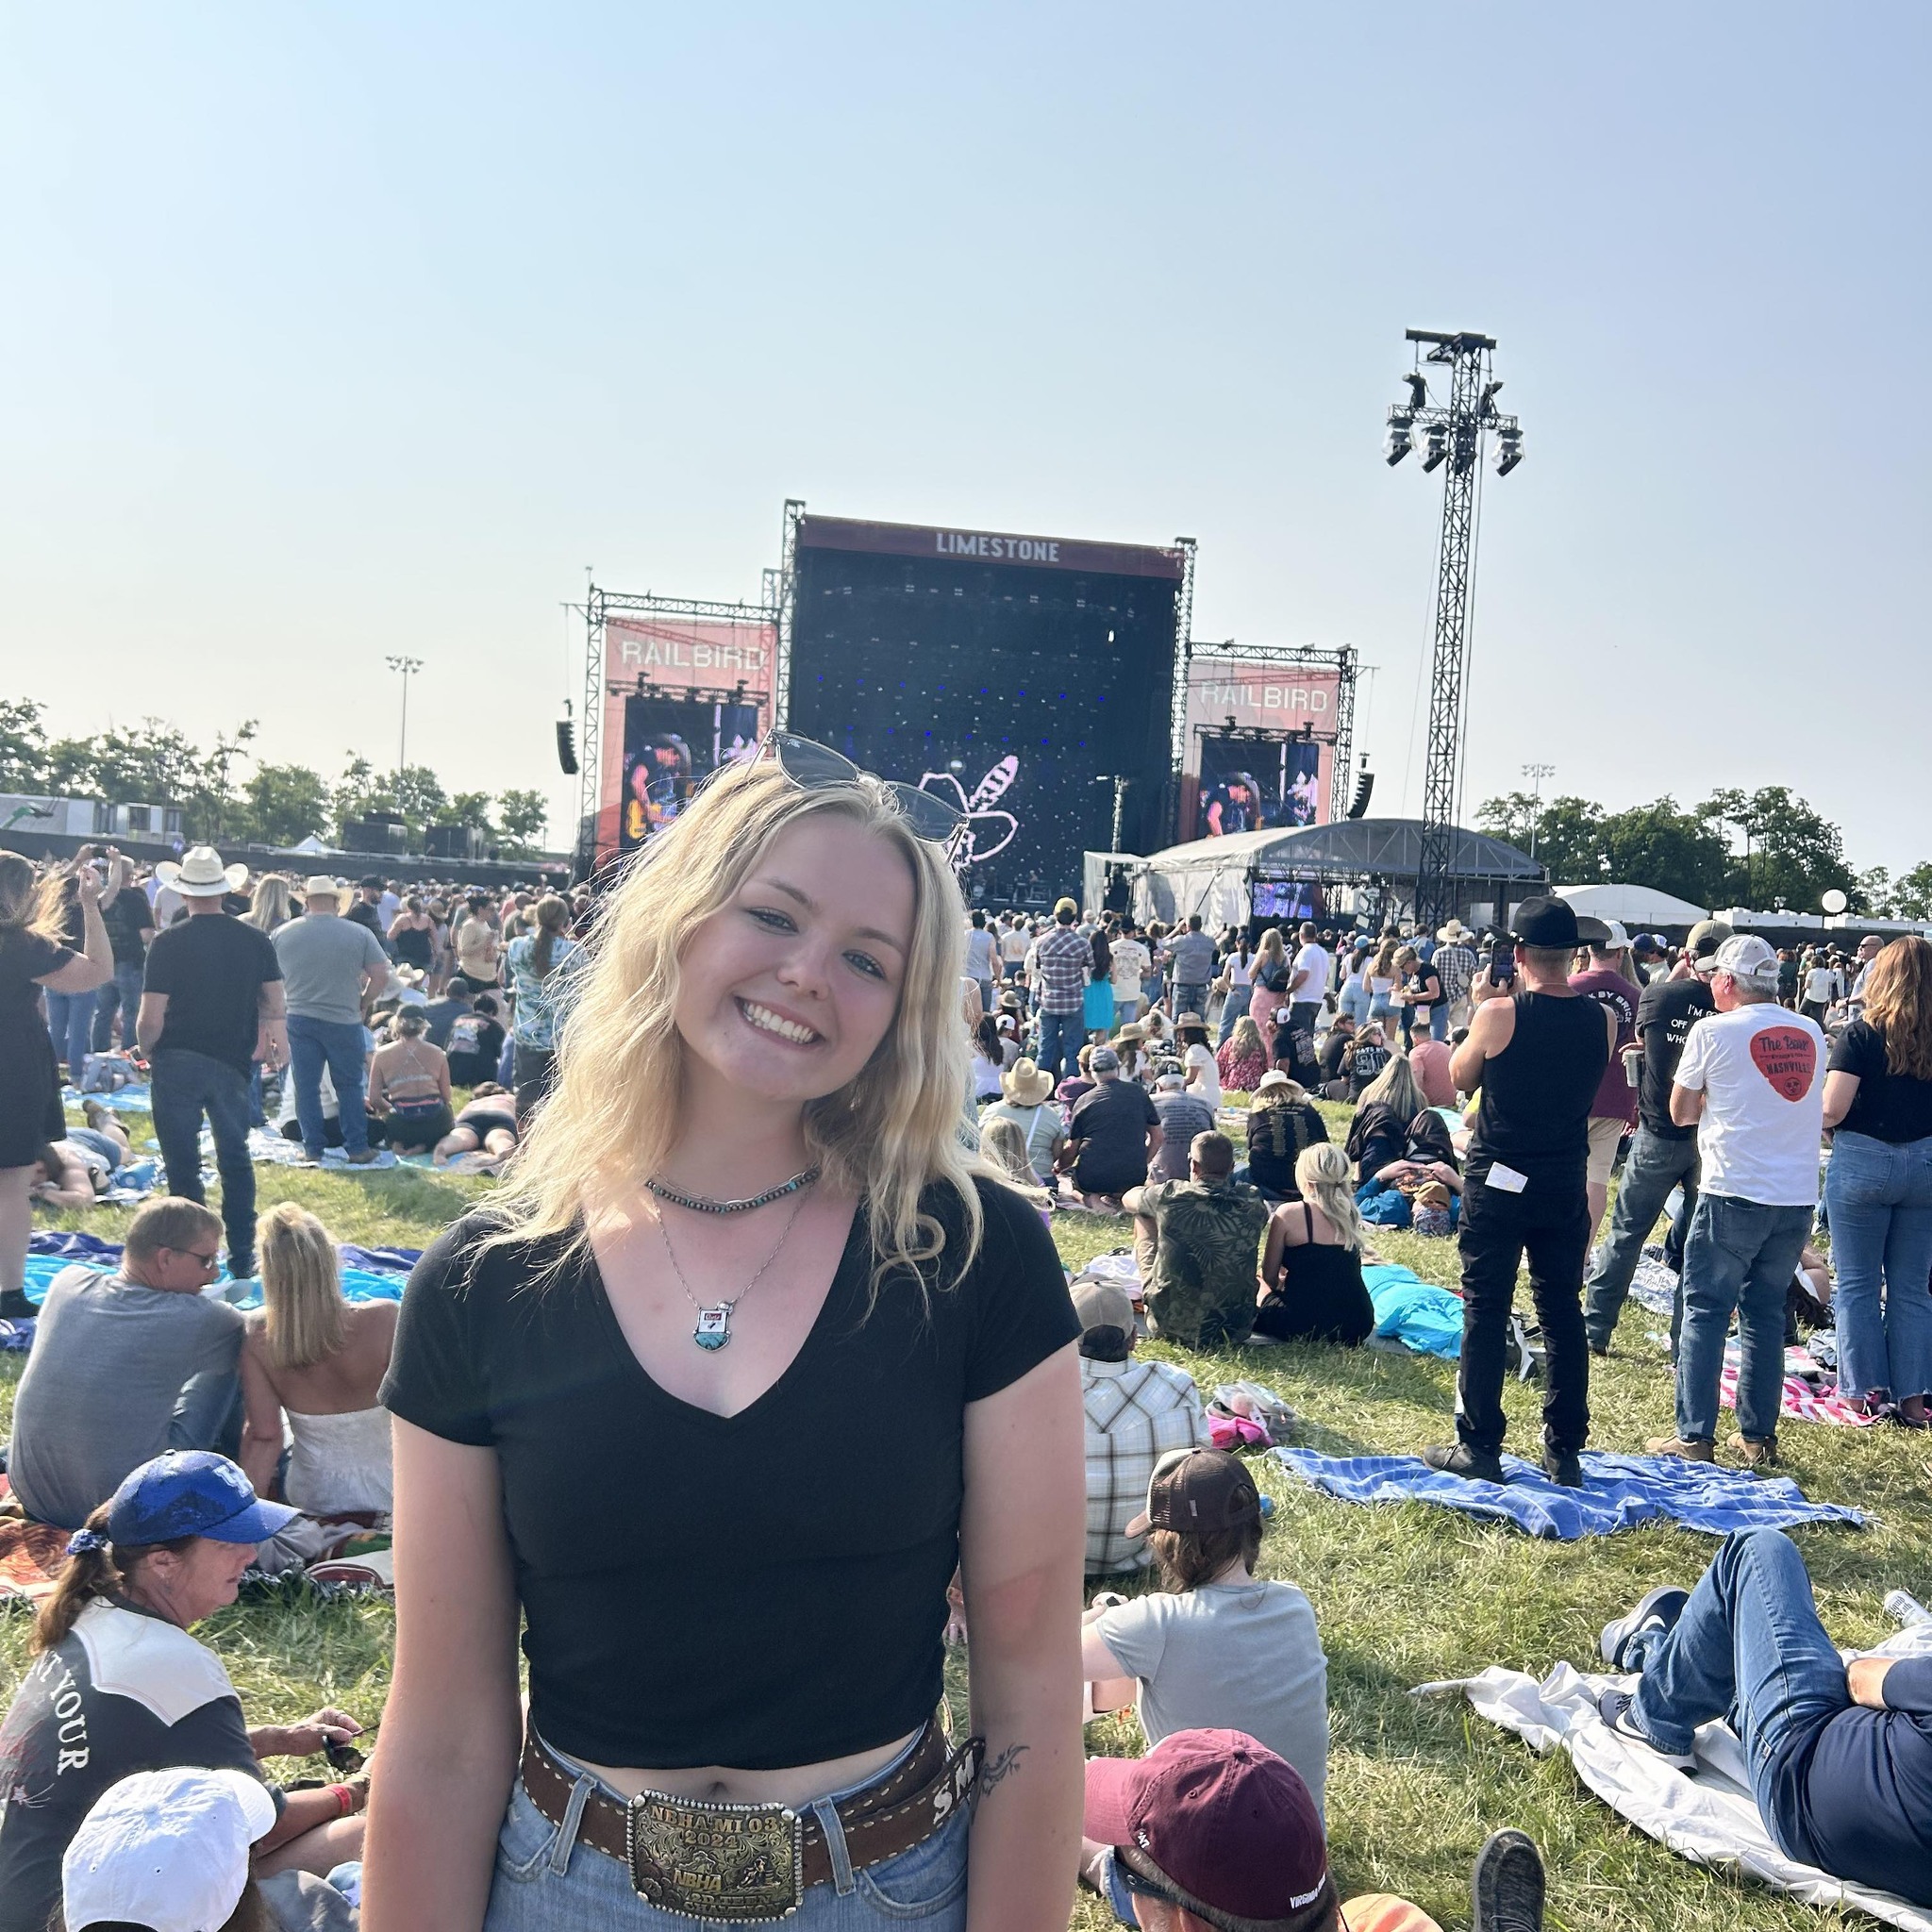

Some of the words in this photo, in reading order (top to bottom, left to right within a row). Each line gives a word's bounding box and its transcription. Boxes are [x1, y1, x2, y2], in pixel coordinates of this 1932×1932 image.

[936, 532, 1059, 562] LIMESTONE
[622, 641, 765, 670] RAILBIRD
[1201, 682, 1327, 712] RAILBIRD
[1615, 995, 1632, 1024] BRICK
[1687, 1004, 1703, 1017] I'M
[1671, 1019, 1689, 1029] OFF
[1758, 1036, 1782, 1052] The
[1766, 1061, 1811, 1074] NASHVILLE
[50, 1668, 91, 1776] YOUR
[650, 1805, 708, 1831] NBHA
[712, 1817, 743, 1833] MI
[748, 1816, 779, 1833] 03
[684, 1829, 739, 1849] 2024
[674, 1868, 722, 1891] NBHA
